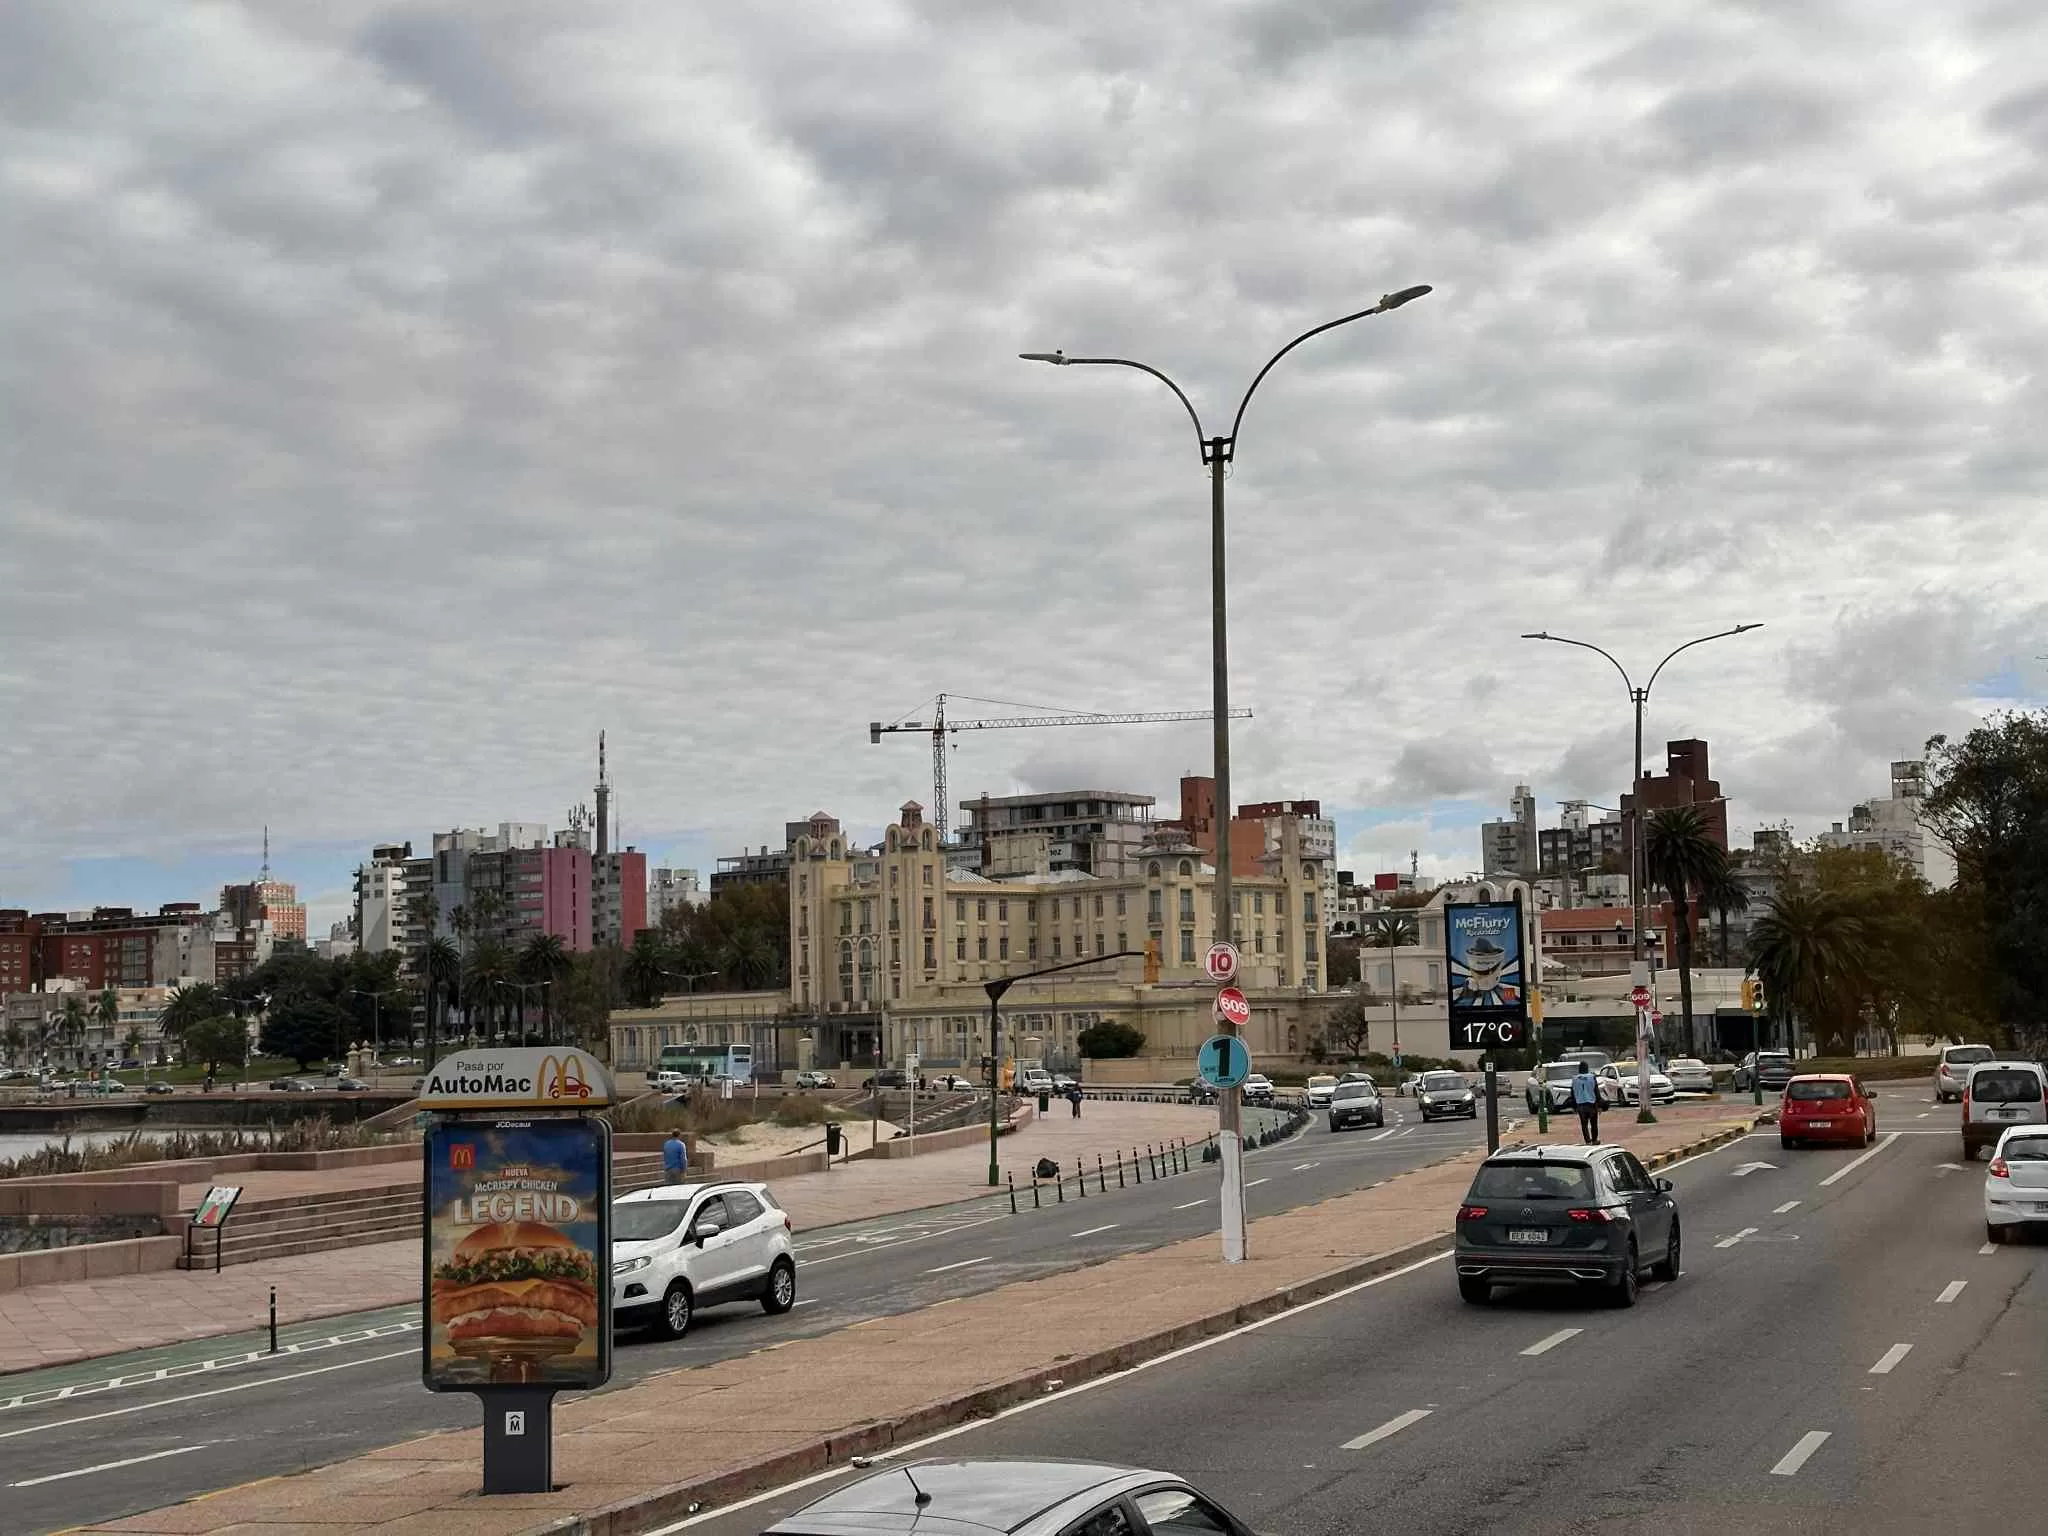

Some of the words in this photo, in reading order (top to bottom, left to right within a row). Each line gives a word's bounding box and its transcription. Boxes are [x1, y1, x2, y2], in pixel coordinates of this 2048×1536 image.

[1455, 916, 1511, 929] McFlurry
[1209, 953, 1233, 972] 10
[1220, 997, 1249, 1016] 609
[1463, 1022, 1513, 1043] 17°C
[1212, 1038, 1231, 1077] 1
[487, 1062, 504, 1076] por
[428, 1075, 532, 1094] AutoMac
[505, 1168, 529, 1177] NUEVA
[521, 1179, 558, 1192] CHICKEN
[453, 1192, 579, 1225] LEGEND
